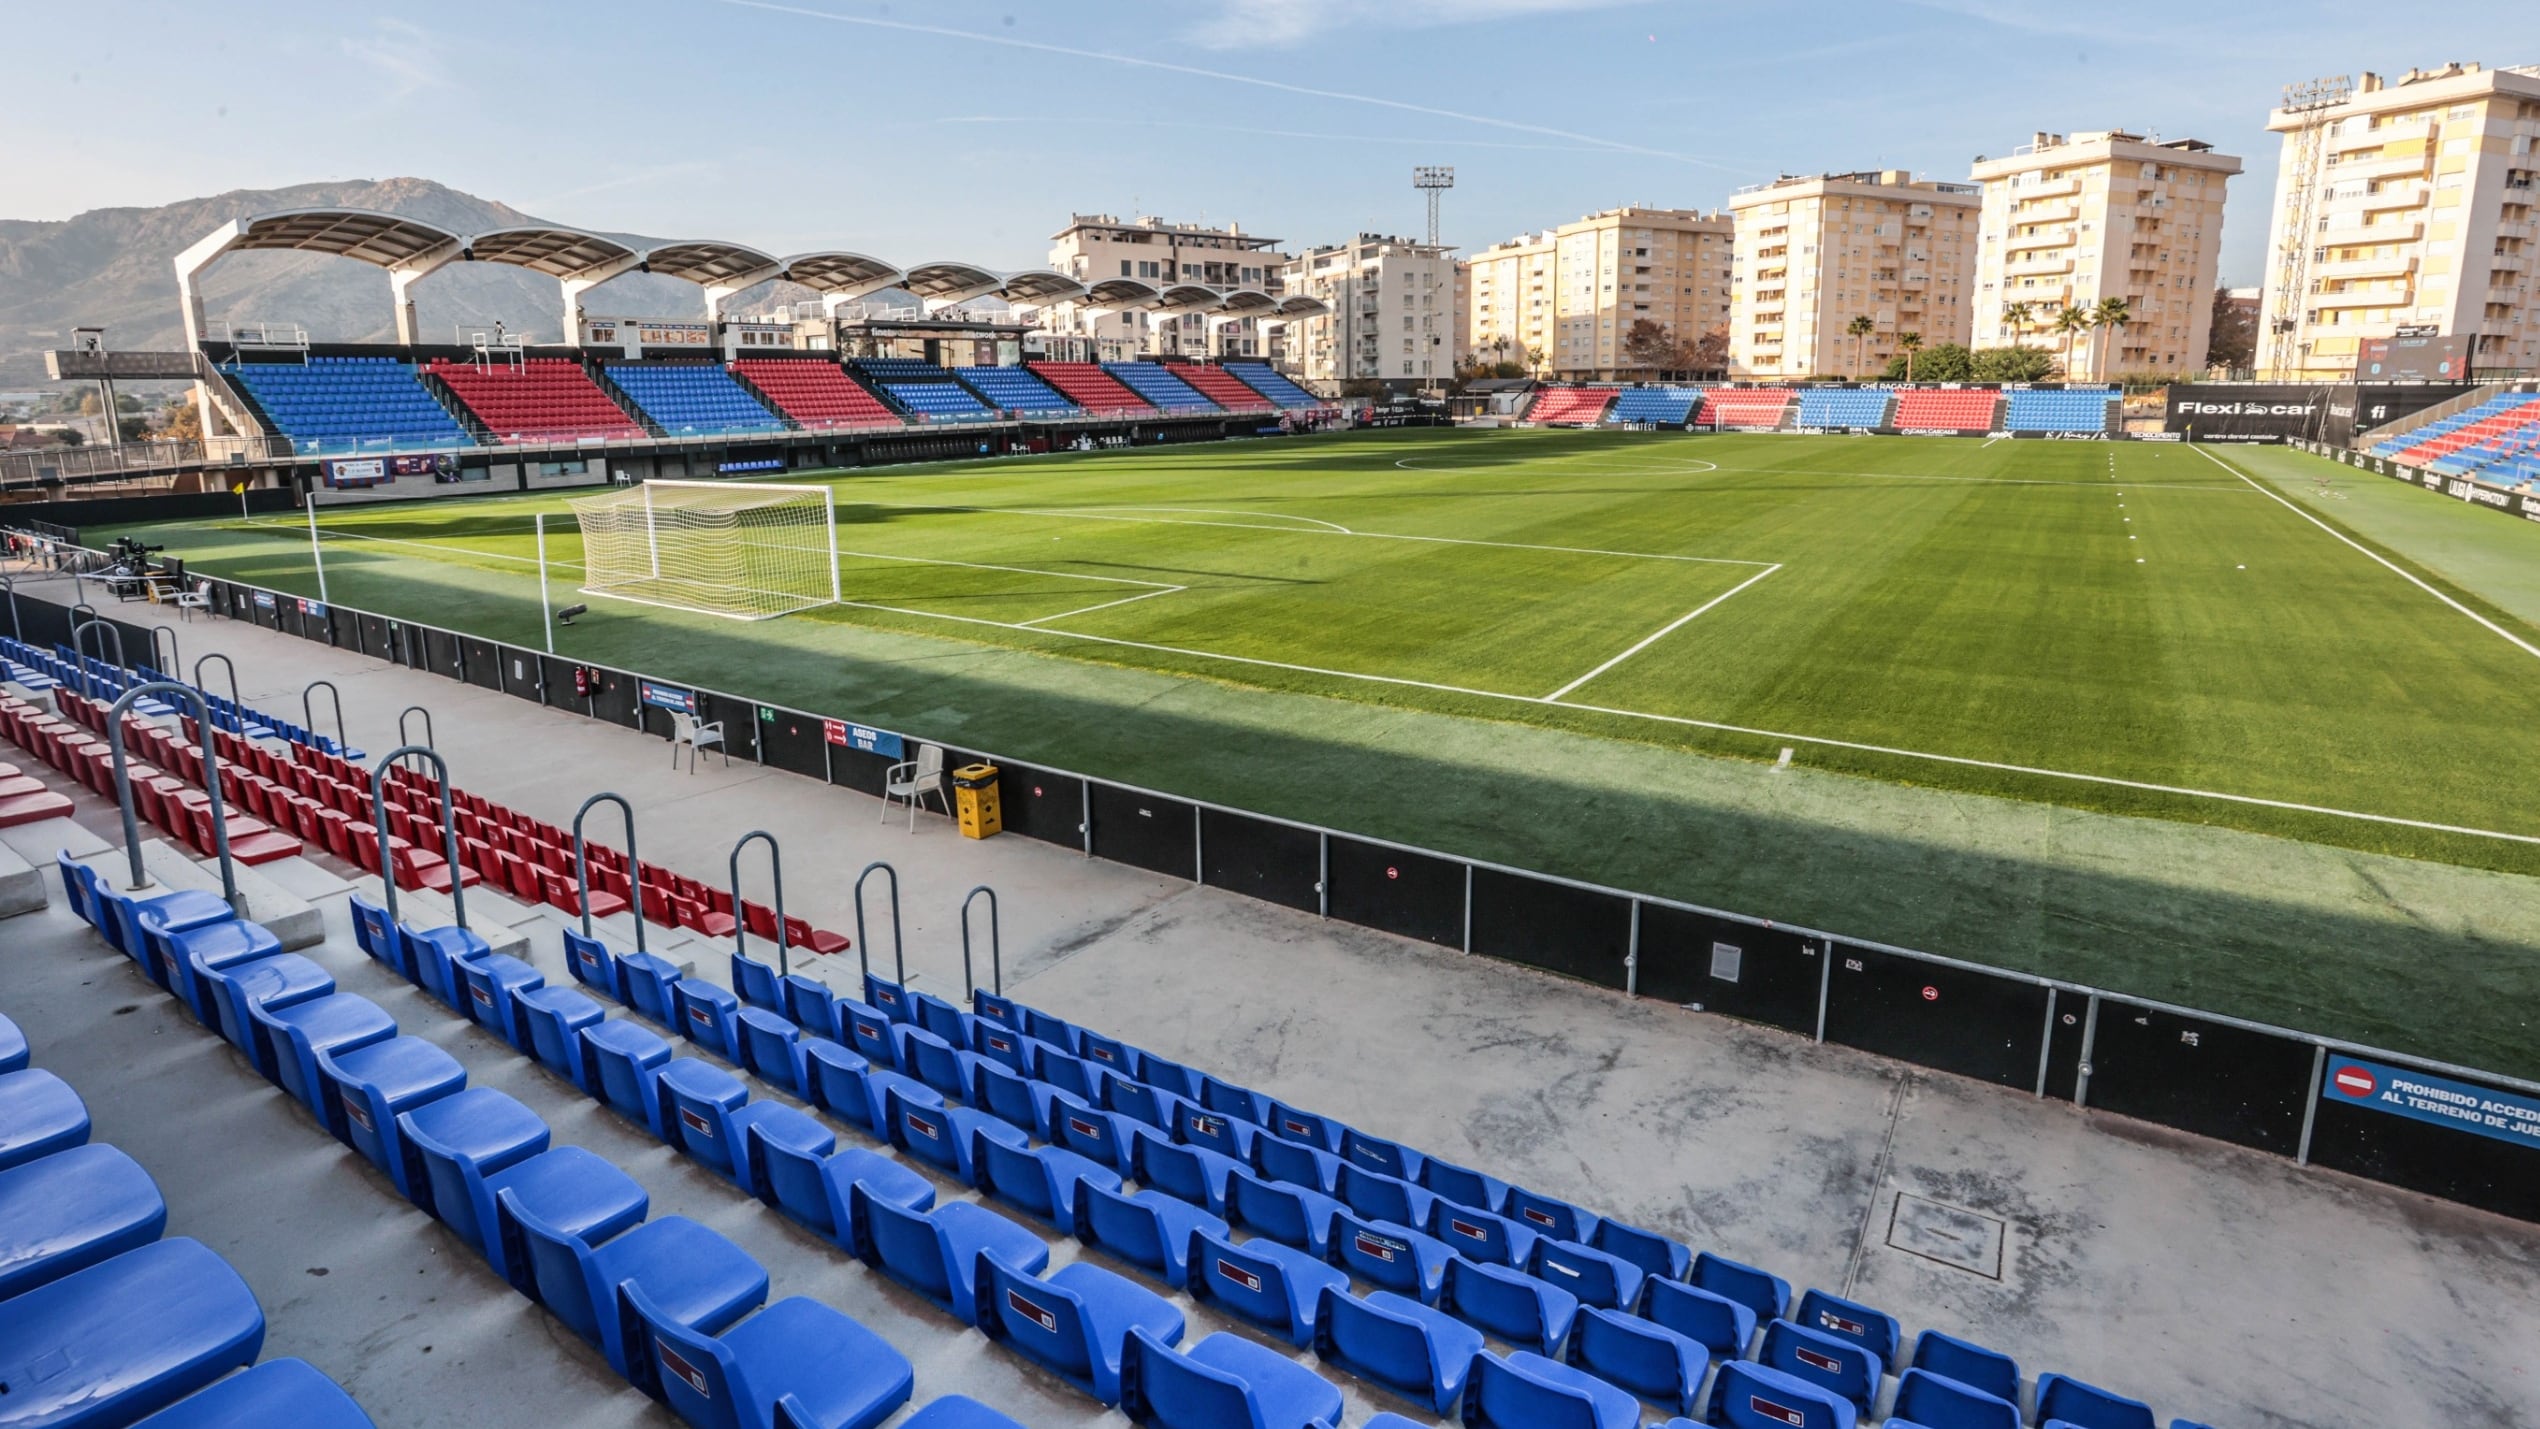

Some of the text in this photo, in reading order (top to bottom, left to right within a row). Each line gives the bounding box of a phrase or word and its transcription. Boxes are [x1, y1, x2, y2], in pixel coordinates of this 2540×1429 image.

[2178, 402, 2241, 415] Flexi
[2270, 405, 2317, 415] car
[857, 738, 874, 752] BAR
[2391, 1079, 2478, 1108] PROHIBIDO
[2380, 1090, 2404, 1105] AL
[2407, 1095, 2482, 1123] TERRENO
[2484, 1114, 2508, 1129] DE
